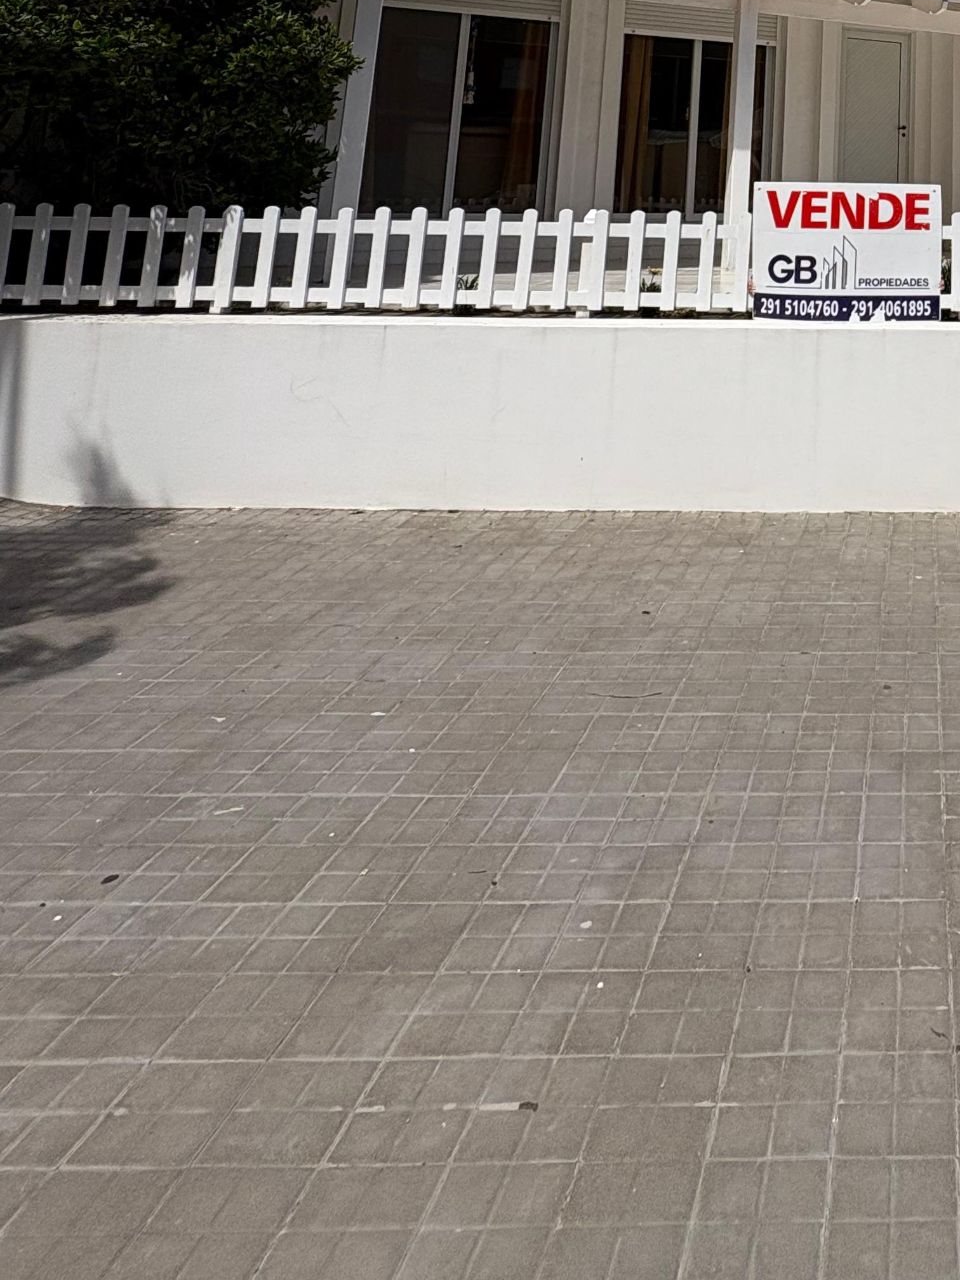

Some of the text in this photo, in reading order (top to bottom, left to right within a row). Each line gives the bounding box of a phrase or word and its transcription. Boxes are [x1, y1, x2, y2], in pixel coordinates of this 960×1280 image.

[767, 191, 930, 230] VENDE
[768, 255, 817, 284] GB
[858, 278, 929, 287] PROPIEDADES
[760, 298, 780, 314] 291
[785, 300, 839, 316] 5104760
[851, 300, 873, 317] 291
[875, 300, 931, 316] 4061895
